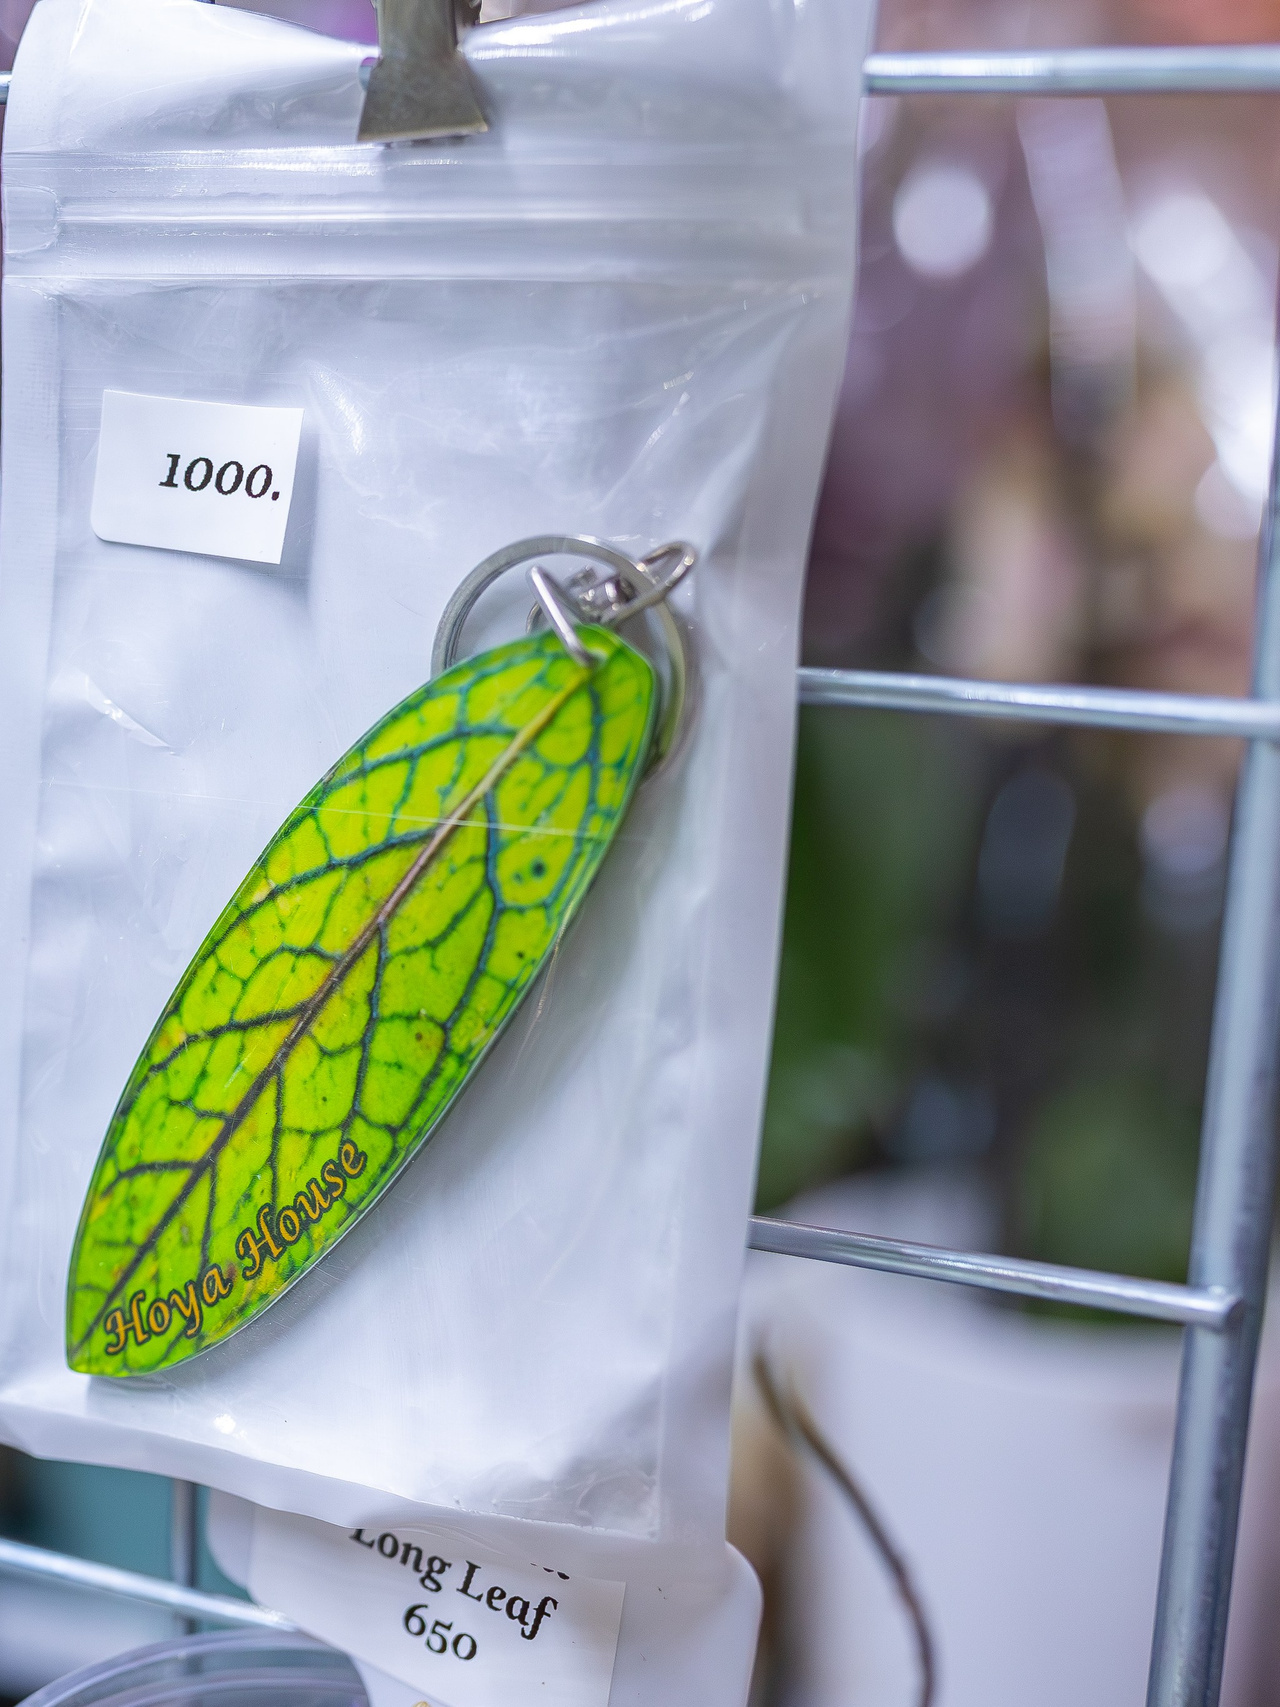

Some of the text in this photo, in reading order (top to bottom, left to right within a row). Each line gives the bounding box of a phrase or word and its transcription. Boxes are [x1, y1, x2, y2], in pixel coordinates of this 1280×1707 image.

[158, 453, 280, 501] 1000.
[104, 1138, 368, 1356] Hoya House
[403, 1603, 478, 1661] 650
[456, 1560, 559, 1640] Leaf
